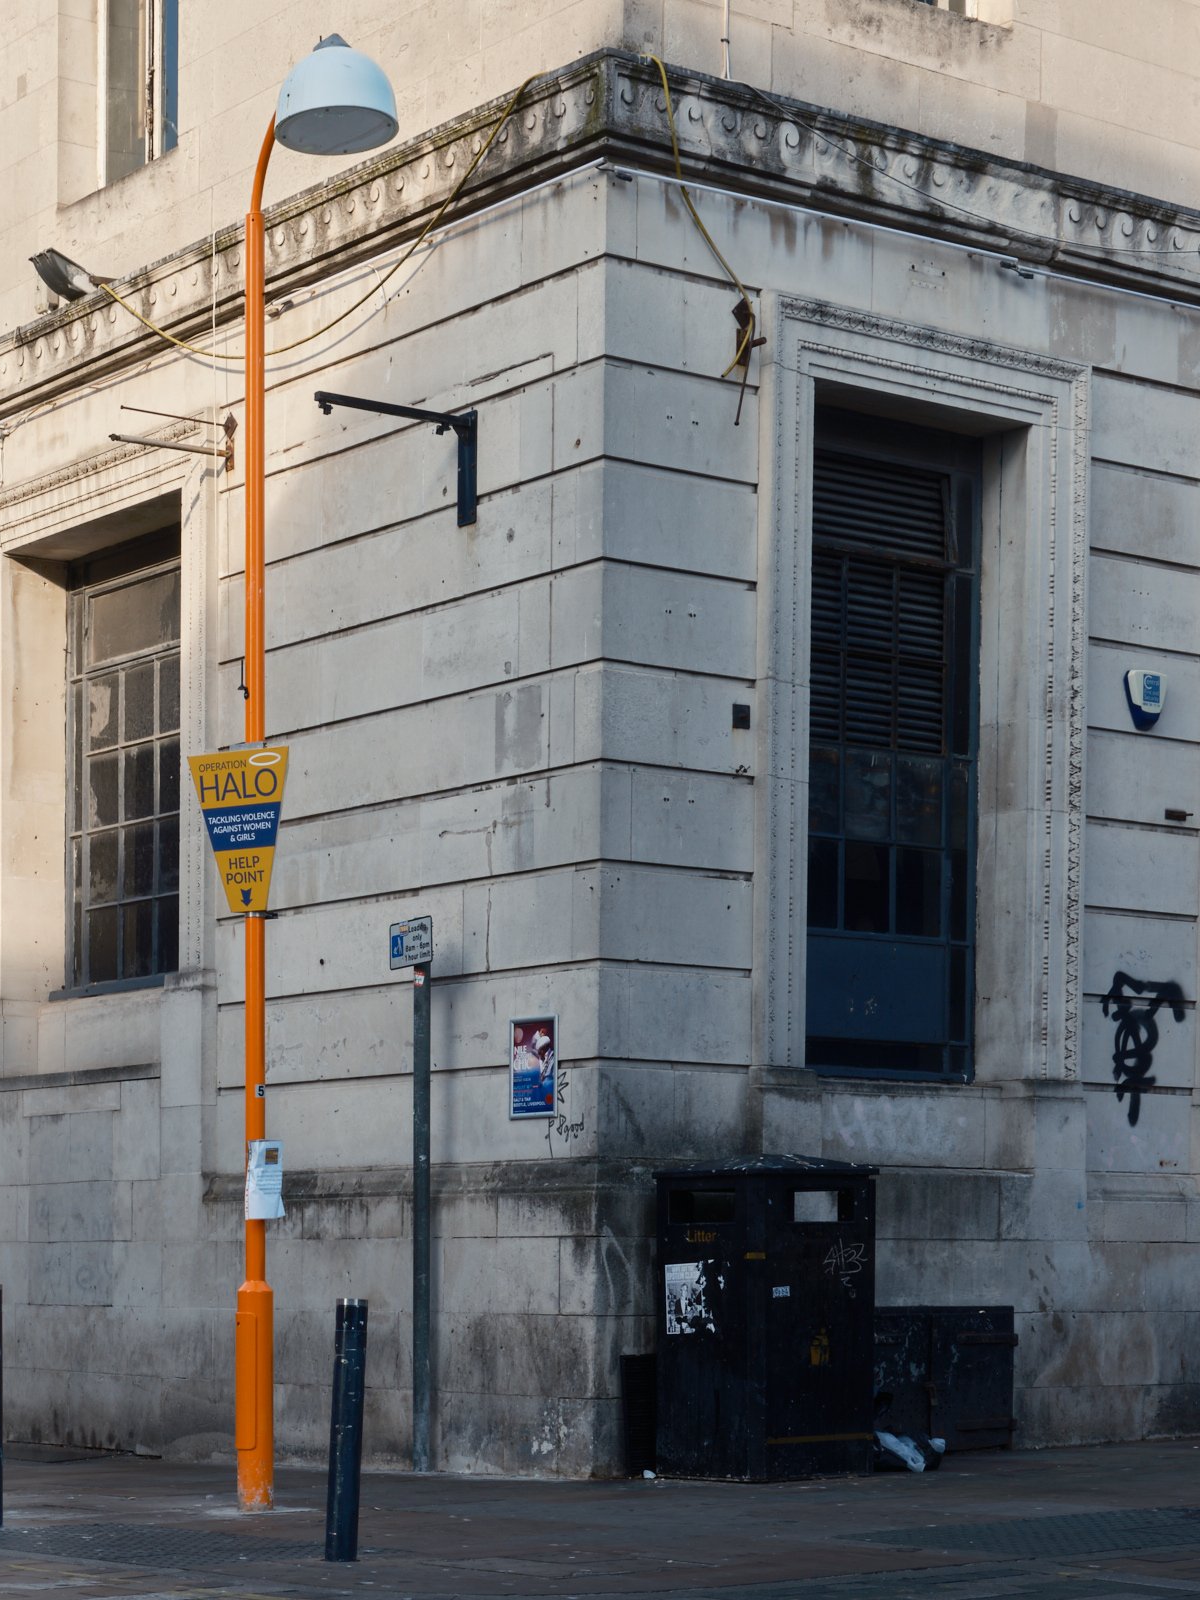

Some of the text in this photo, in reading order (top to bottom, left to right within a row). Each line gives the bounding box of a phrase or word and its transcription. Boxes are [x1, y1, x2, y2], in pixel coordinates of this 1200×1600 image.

[199, 760, 247, 773] OPERATION
[200, 768, 278, 803] HALO
[208, 811, 275, 825] TACKLING VIOLENCE
[213, 822, 272, 834] AGAINST WOMEN
[237, 833, 256, 841] GIRLS
[229, 856, 260, 870] HELP
[226, 870, 265, 885] POINT
[412, 933, 422, 942] only
[687, 1229, 717, 1243] Litter
